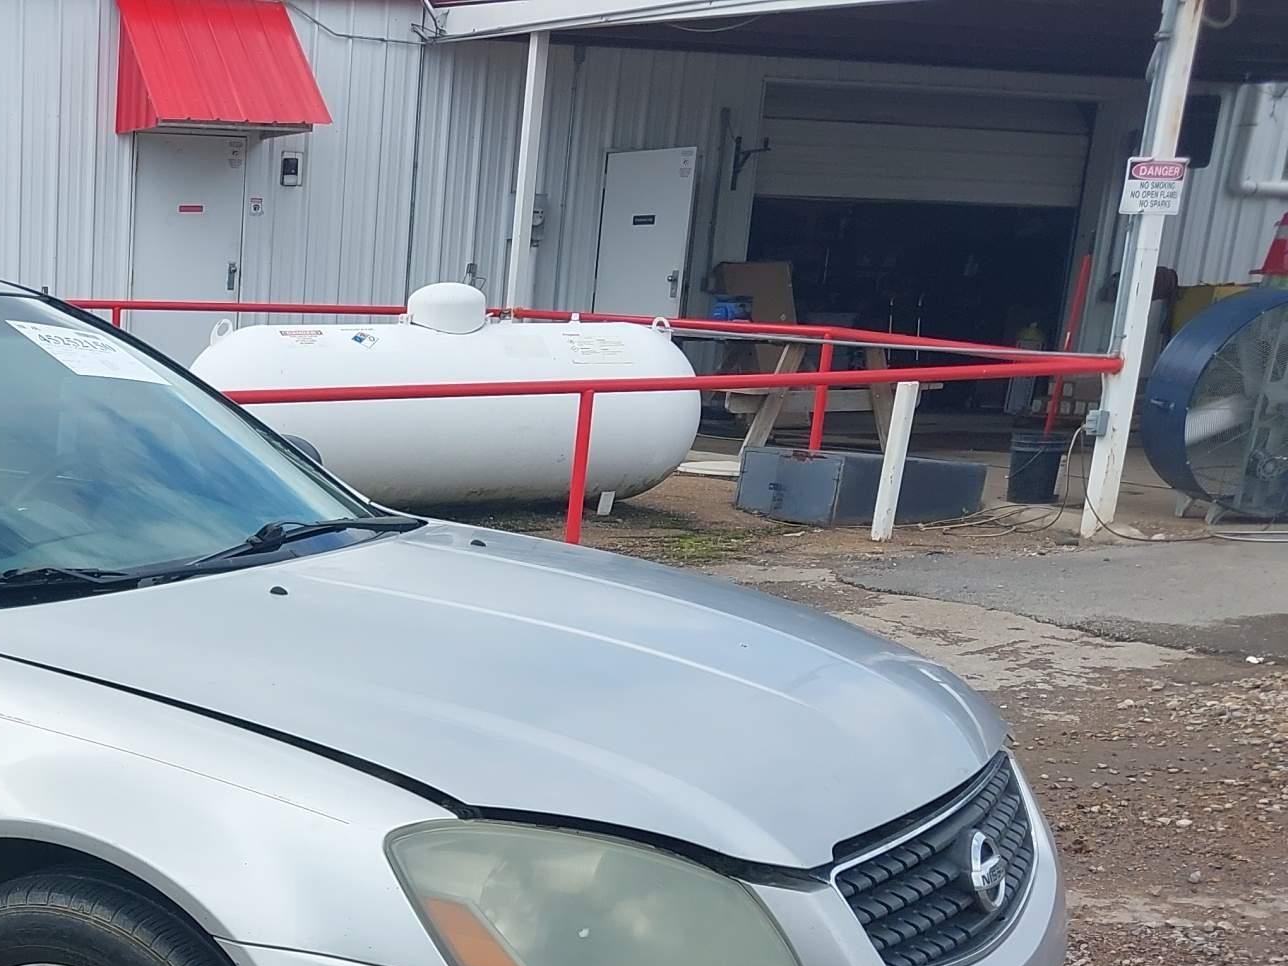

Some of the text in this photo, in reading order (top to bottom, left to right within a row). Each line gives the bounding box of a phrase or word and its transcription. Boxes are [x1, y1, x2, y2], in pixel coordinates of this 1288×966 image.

[1139, 165, 1180, 177] DANGER
[1140, 181, 1175, 190] NO SMOKING
[1130, 191, 1140, 199] NO
[1142, 191, 1158, 199] OPEN
[1139, 200, 1170, 208] NO SPARKS
